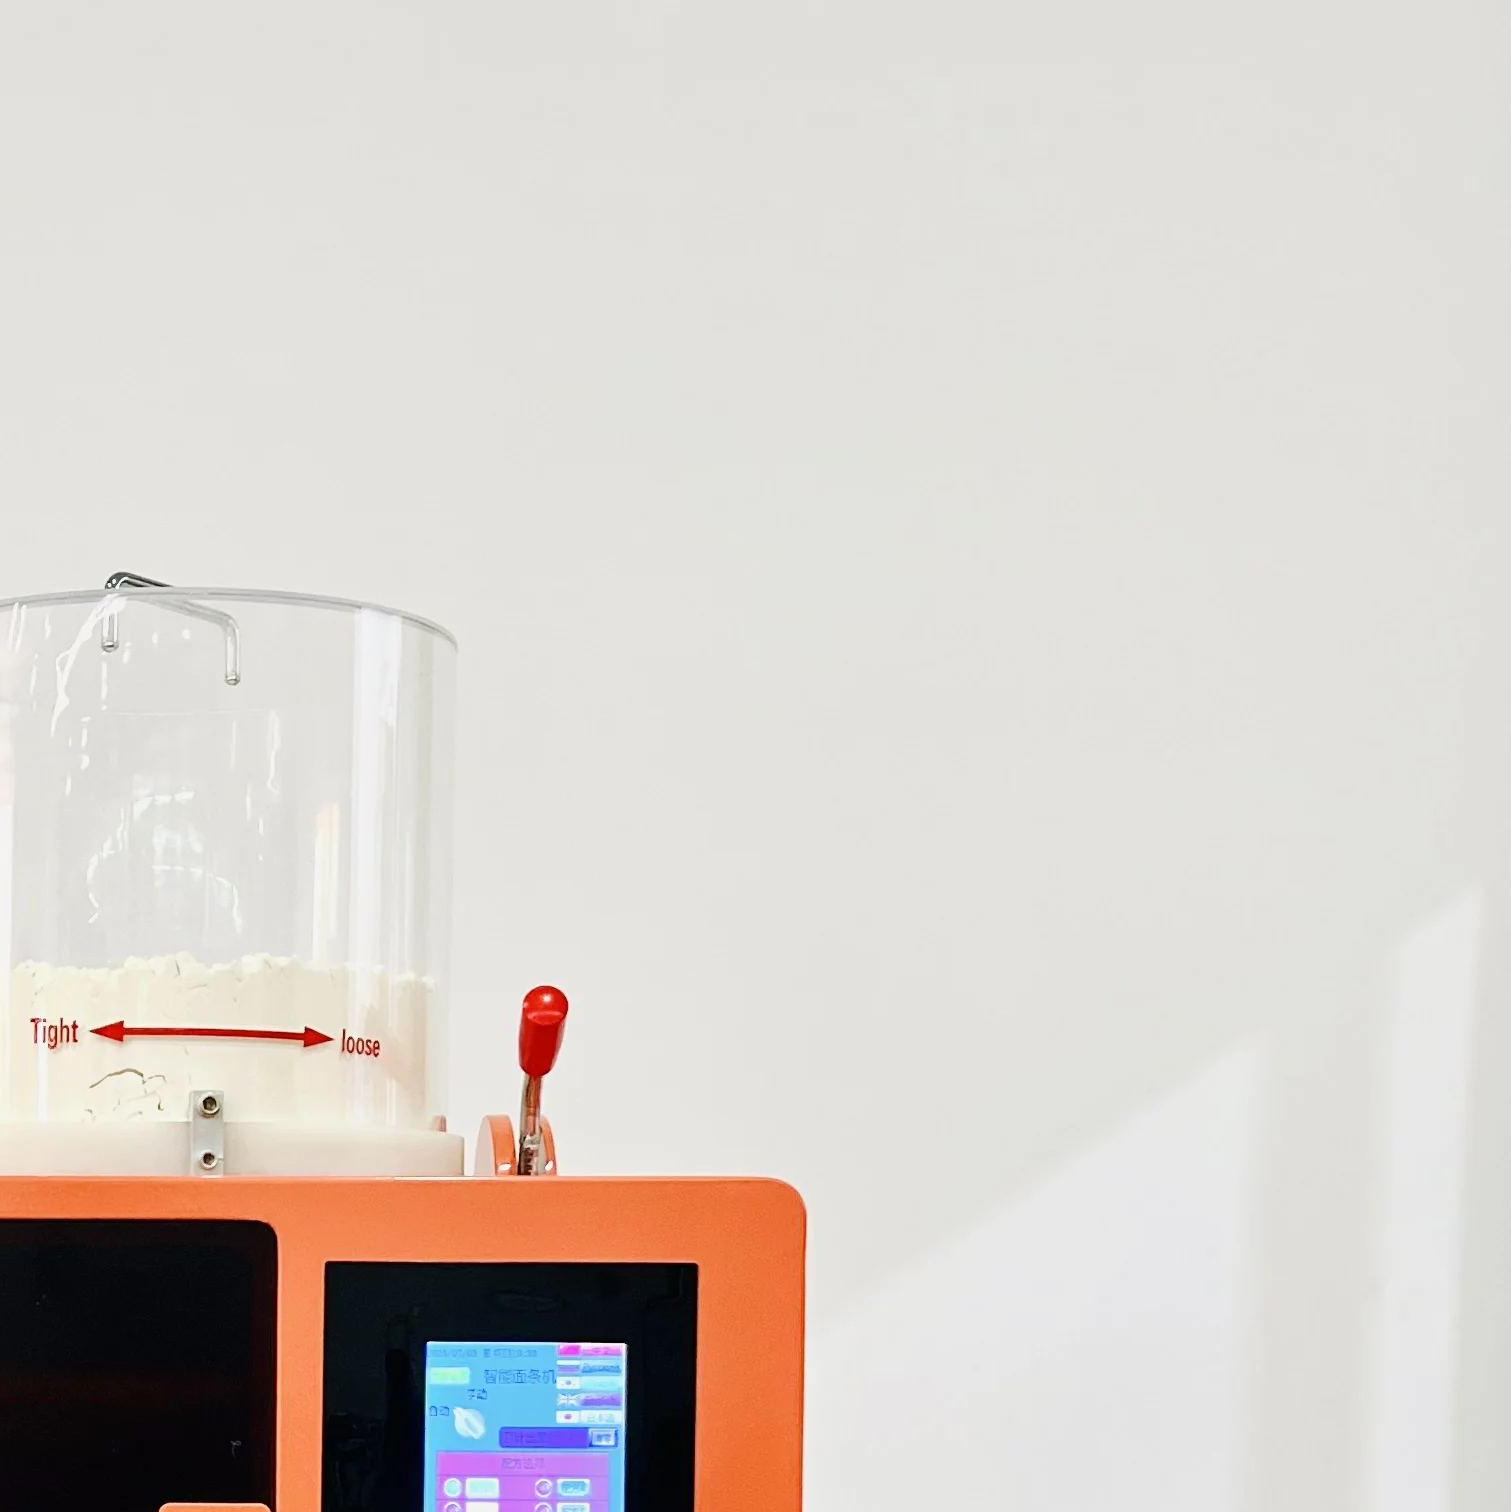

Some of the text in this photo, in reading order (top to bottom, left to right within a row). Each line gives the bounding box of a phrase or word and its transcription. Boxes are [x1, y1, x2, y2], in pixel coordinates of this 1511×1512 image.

[29, 1017, 79, 1050] Tight
[341, 1028, 381, 1058] loose
[483, 1368, 557, 1385] 智能面条机
